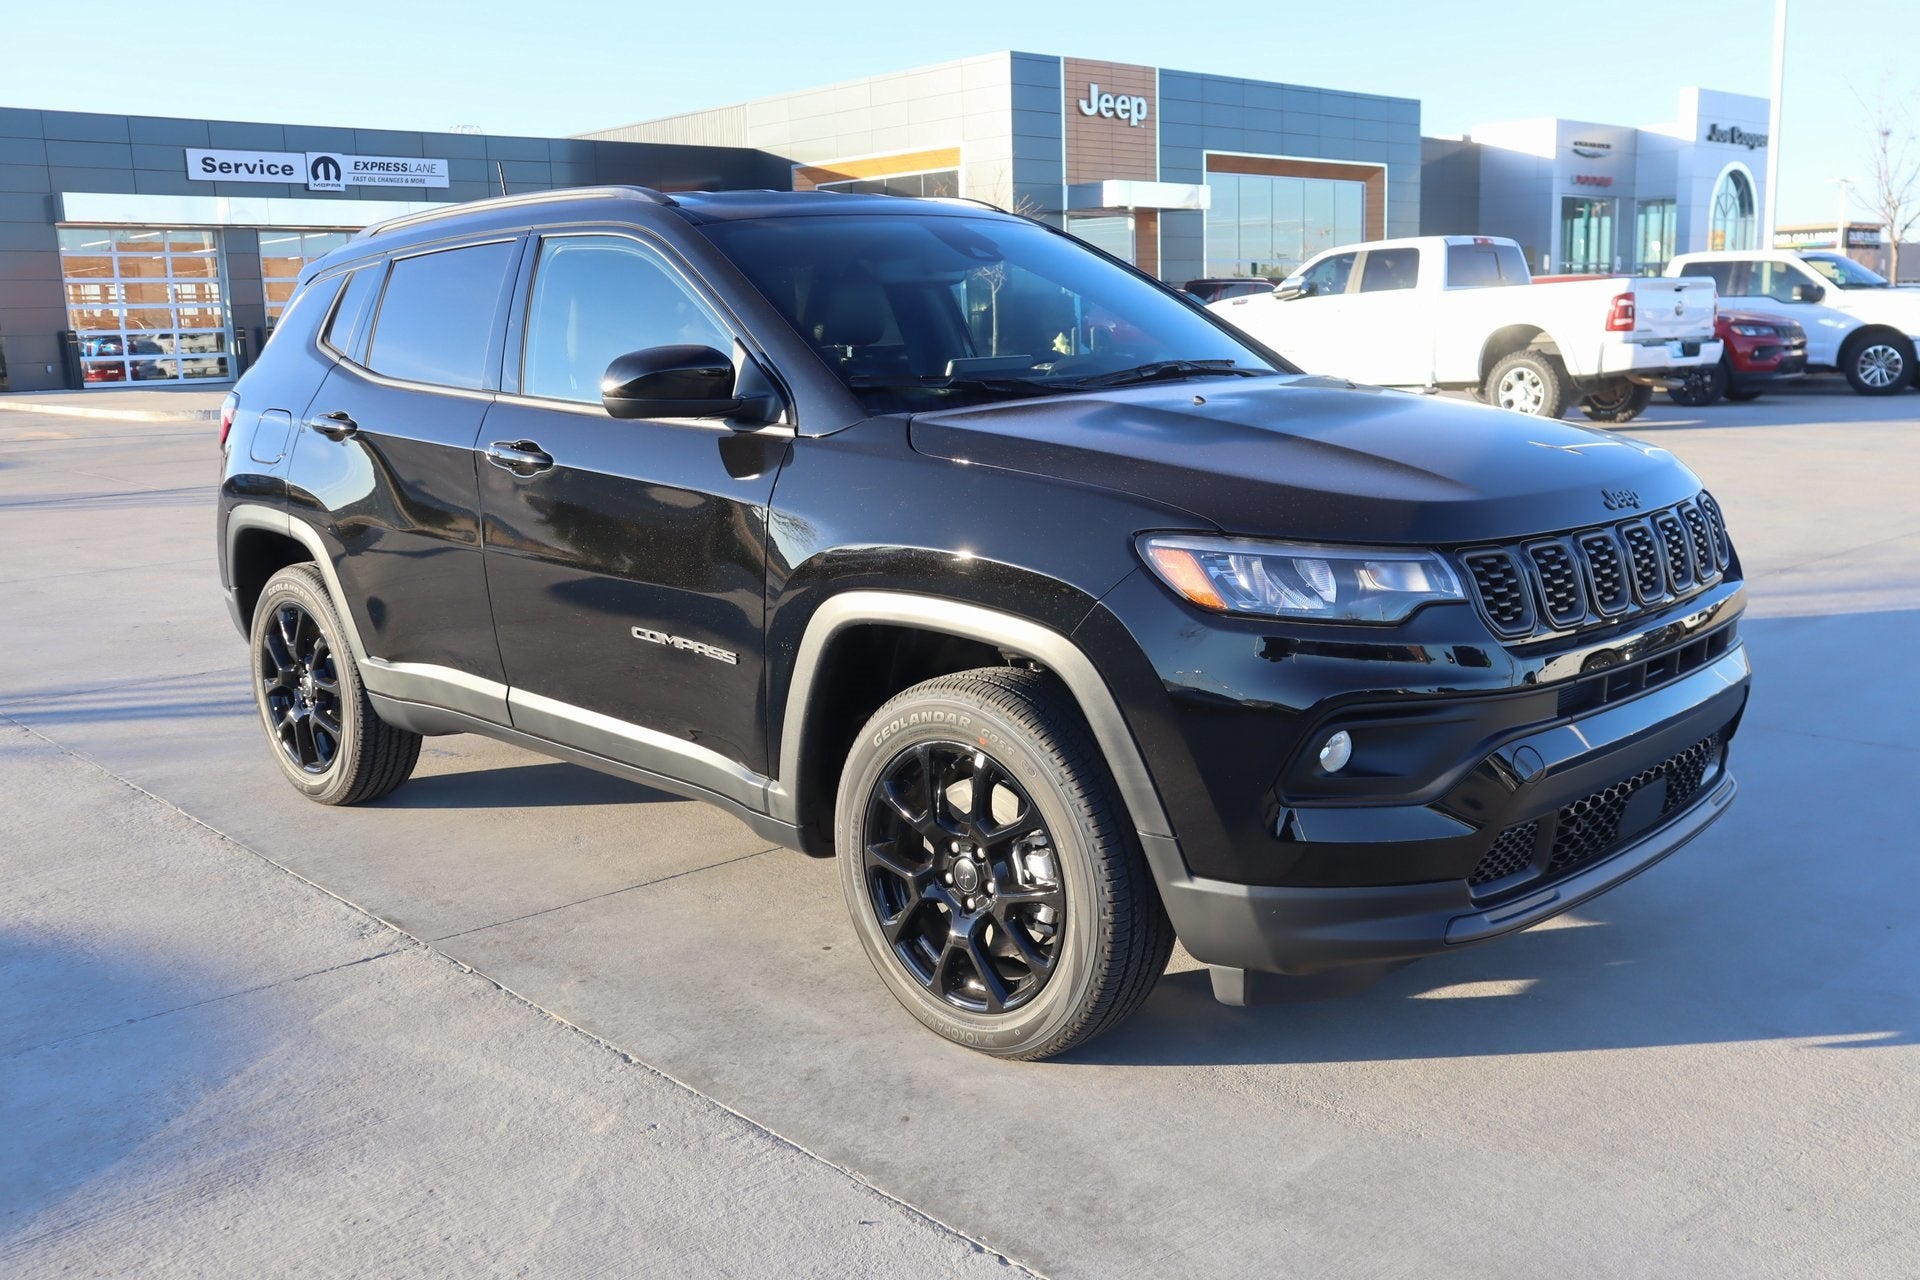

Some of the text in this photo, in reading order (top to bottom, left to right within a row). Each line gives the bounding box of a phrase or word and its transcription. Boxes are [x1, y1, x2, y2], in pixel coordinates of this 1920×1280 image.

[1079, 82, 1147, 126] Jeep
[201, 156, 294, 176] Service
[377, 176, 403, 184] CHANGES
[1601, 488, 1641, 510] Jeep
[630, 625, 740, 665] COMPASS
[872, 710, 972, 748] GEOLANDAR
[922, 1011, 982, 1045] YOKOHAMA
